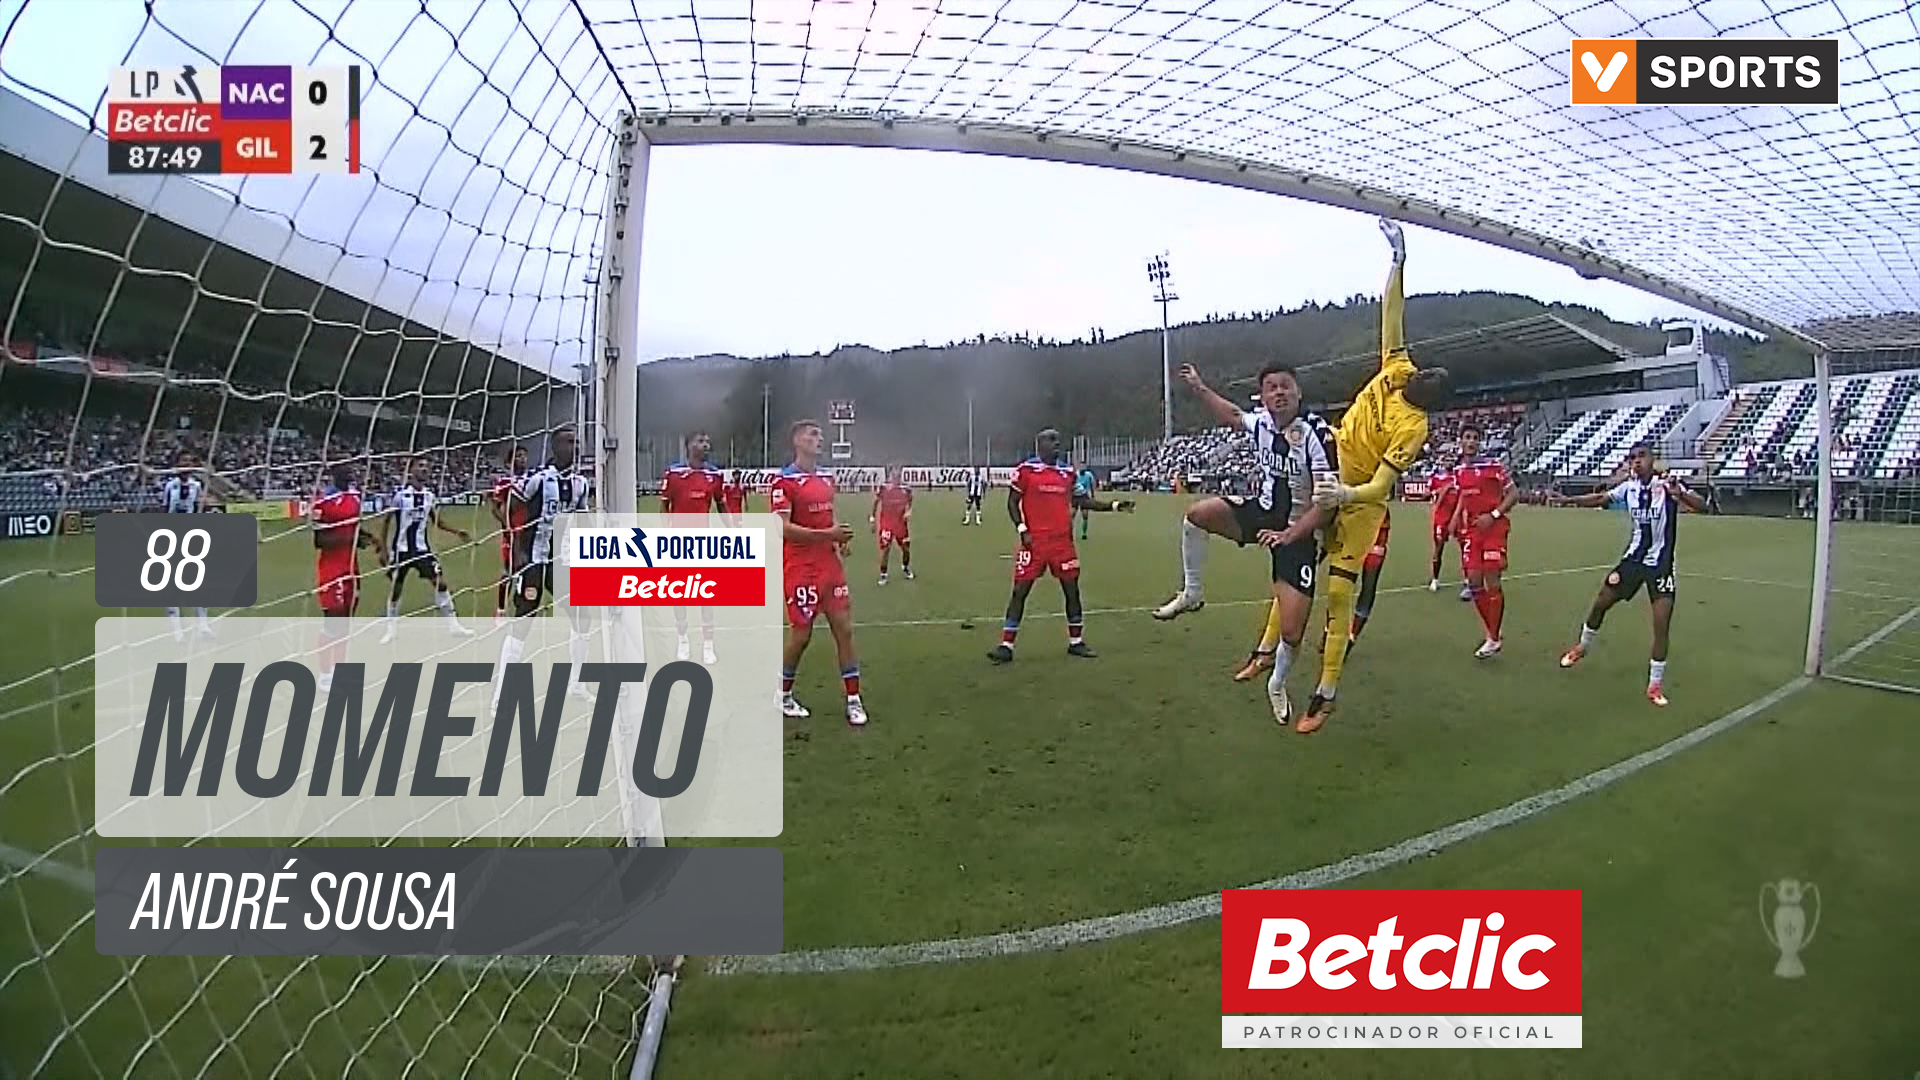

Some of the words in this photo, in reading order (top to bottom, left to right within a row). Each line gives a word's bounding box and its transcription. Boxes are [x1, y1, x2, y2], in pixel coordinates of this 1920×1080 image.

[1262, 447, 1300, 475] CORAL
[8, 515, 51, 536] MEO
[1300, 565, 1313, 588] 9
[1656, 575, 1674, 592] 24
[796, 585, 818, 606] 95
